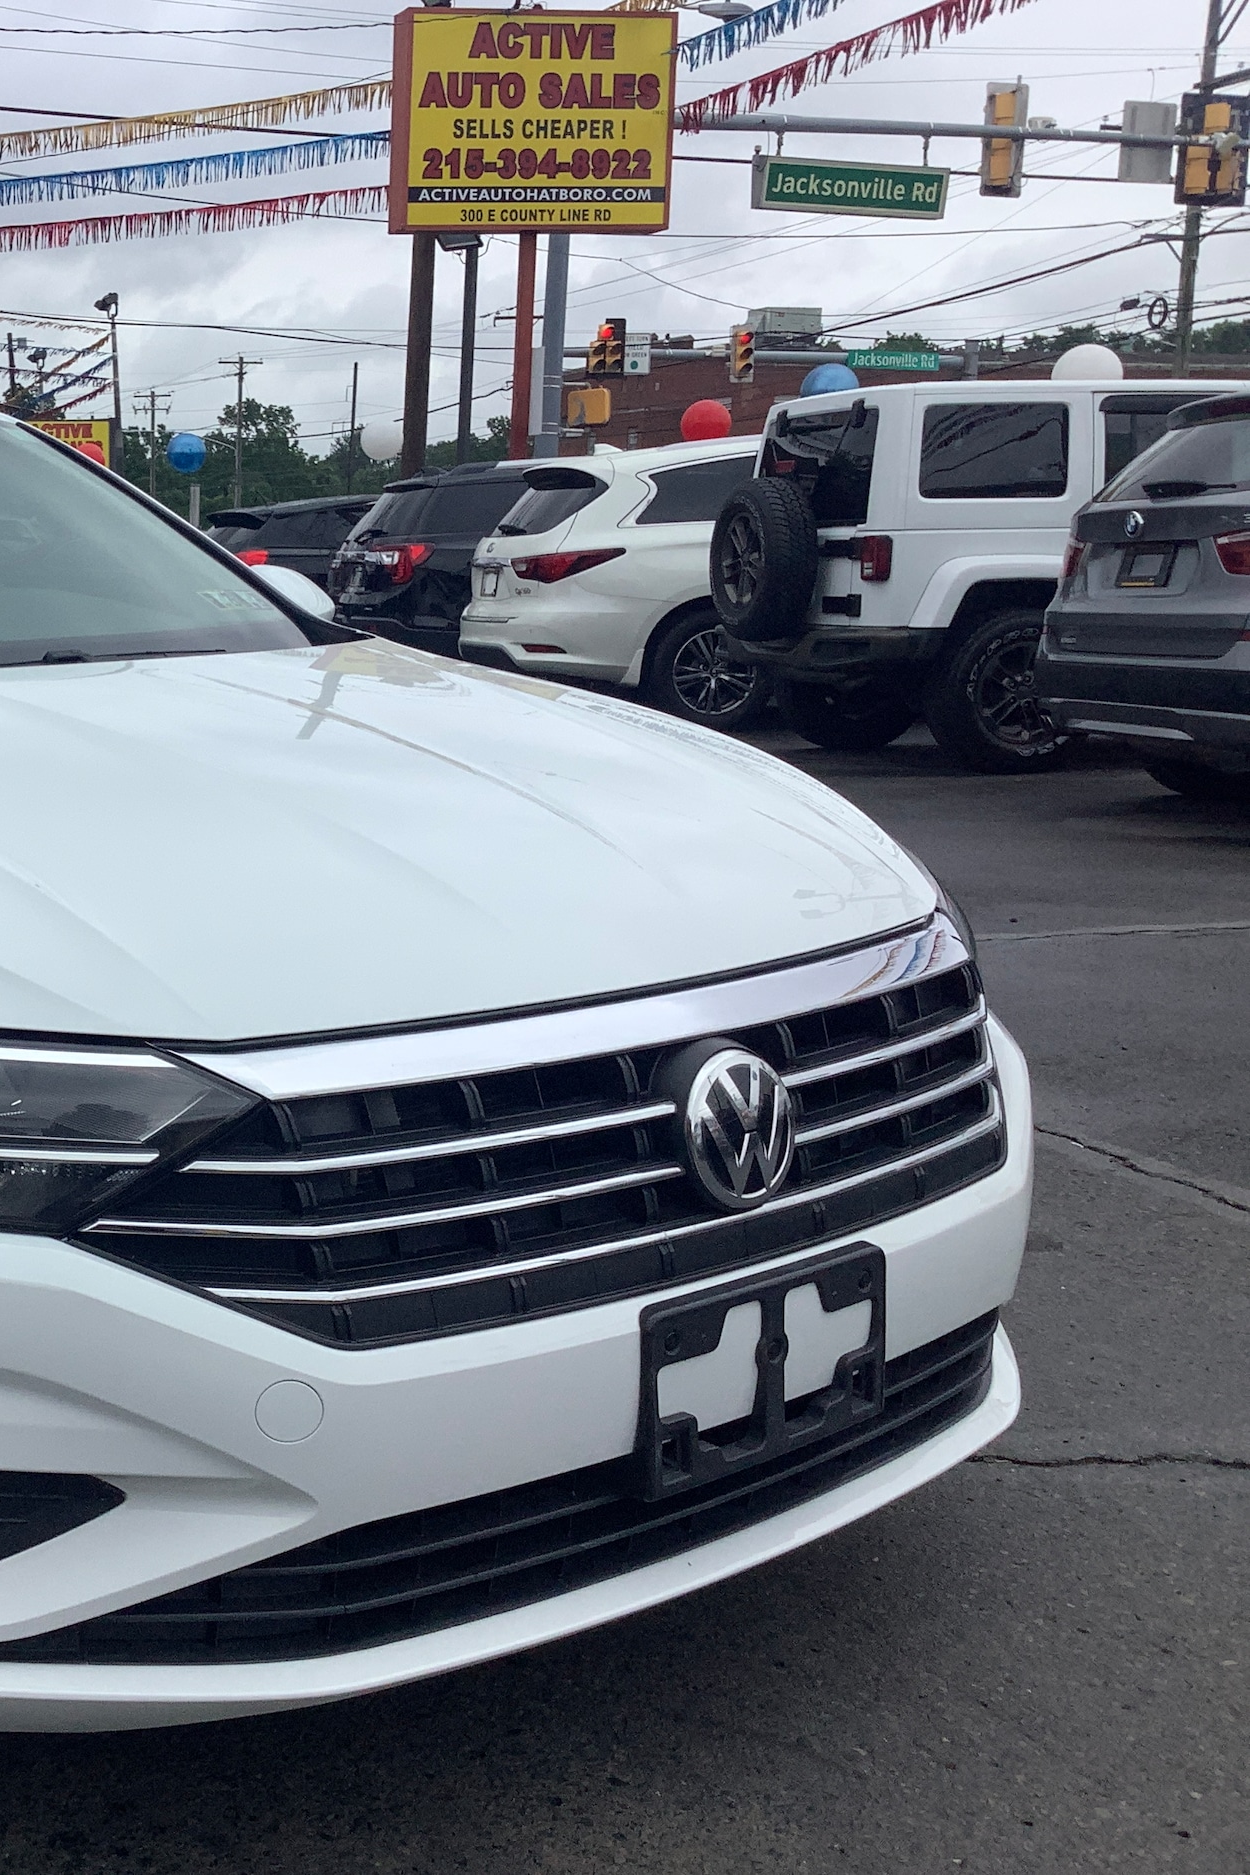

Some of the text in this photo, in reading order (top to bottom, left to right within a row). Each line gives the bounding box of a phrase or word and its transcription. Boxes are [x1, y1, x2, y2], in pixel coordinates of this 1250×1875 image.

[468, 22, 616, 59] ACTIVE
[418, 71, 661, 109] AUTO SALES
[453, 118, 514, 139] SELLS
[522, 119, 614, 139] CHEAPER
[422, 148, 652, 179] 215-394-8922
[419, 188, 650, 201] ACTIVEAUTOHATBORO.COM
[771, 173, 939, 203] Jacksonville Rd
[460, 210, 611, 222] 300 E COUNTY LINE RD
[852, 353, 934, 368] Jacksonville Rd
[33, 423, 93, 438] CTIVE
